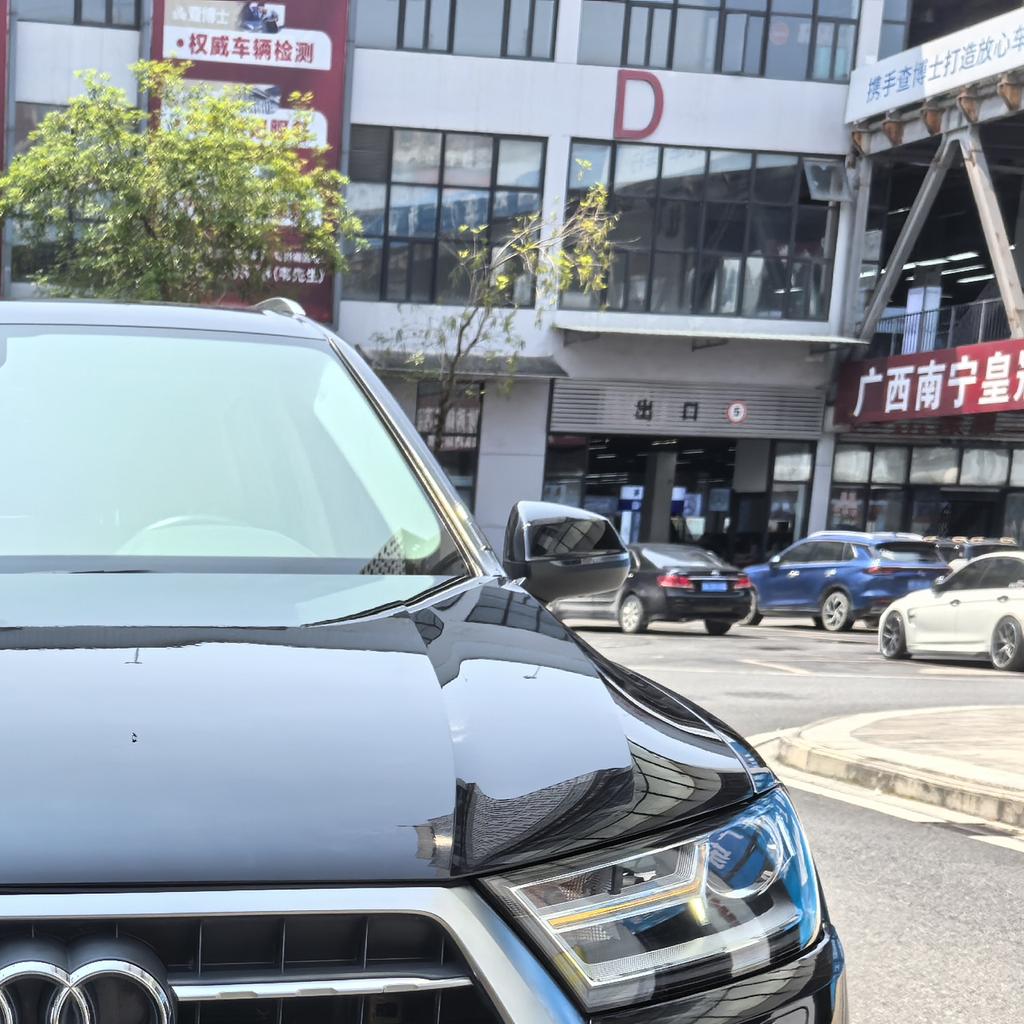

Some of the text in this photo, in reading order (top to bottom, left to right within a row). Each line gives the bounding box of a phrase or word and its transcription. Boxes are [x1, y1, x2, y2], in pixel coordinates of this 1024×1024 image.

[188, 33, 315, 64] 权威车辆检测
[614, 69, 664, 140] D
